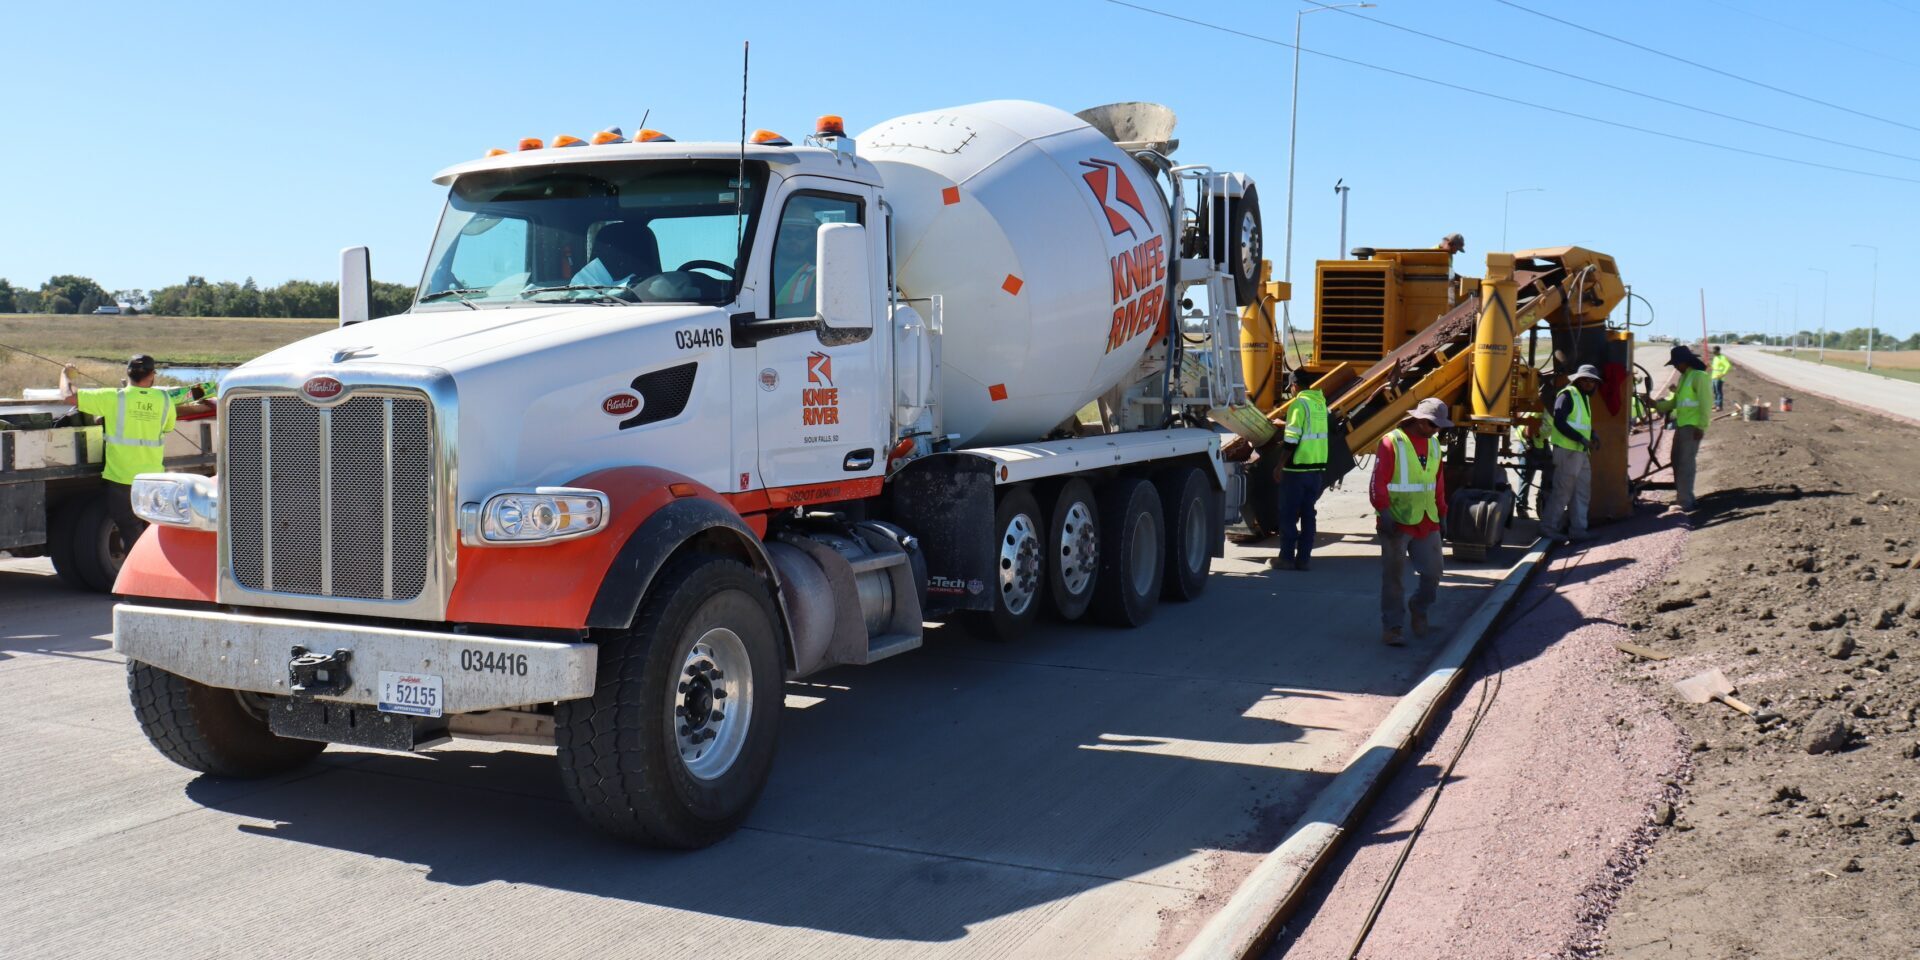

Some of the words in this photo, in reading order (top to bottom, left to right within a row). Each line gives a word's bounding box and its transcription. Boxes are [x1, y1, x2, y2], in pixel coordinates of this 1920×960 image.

[1110, 234, 1165, 305] KNIFE
[1105, 285, 1163, 355] RIVER
[675, 328, 724, 349] 034416
[307, 381, 339, 393] Peterbilt
[606, 398, 636, 411] Peterbilt
[803, 388, 838, 406] KNIFE
[803, 407, 839, 425] RIVER
[787, 490, 815, 502] USDOT
[461, 649, 528, 676] 034416
[396, 684, 436, 707] 52155
